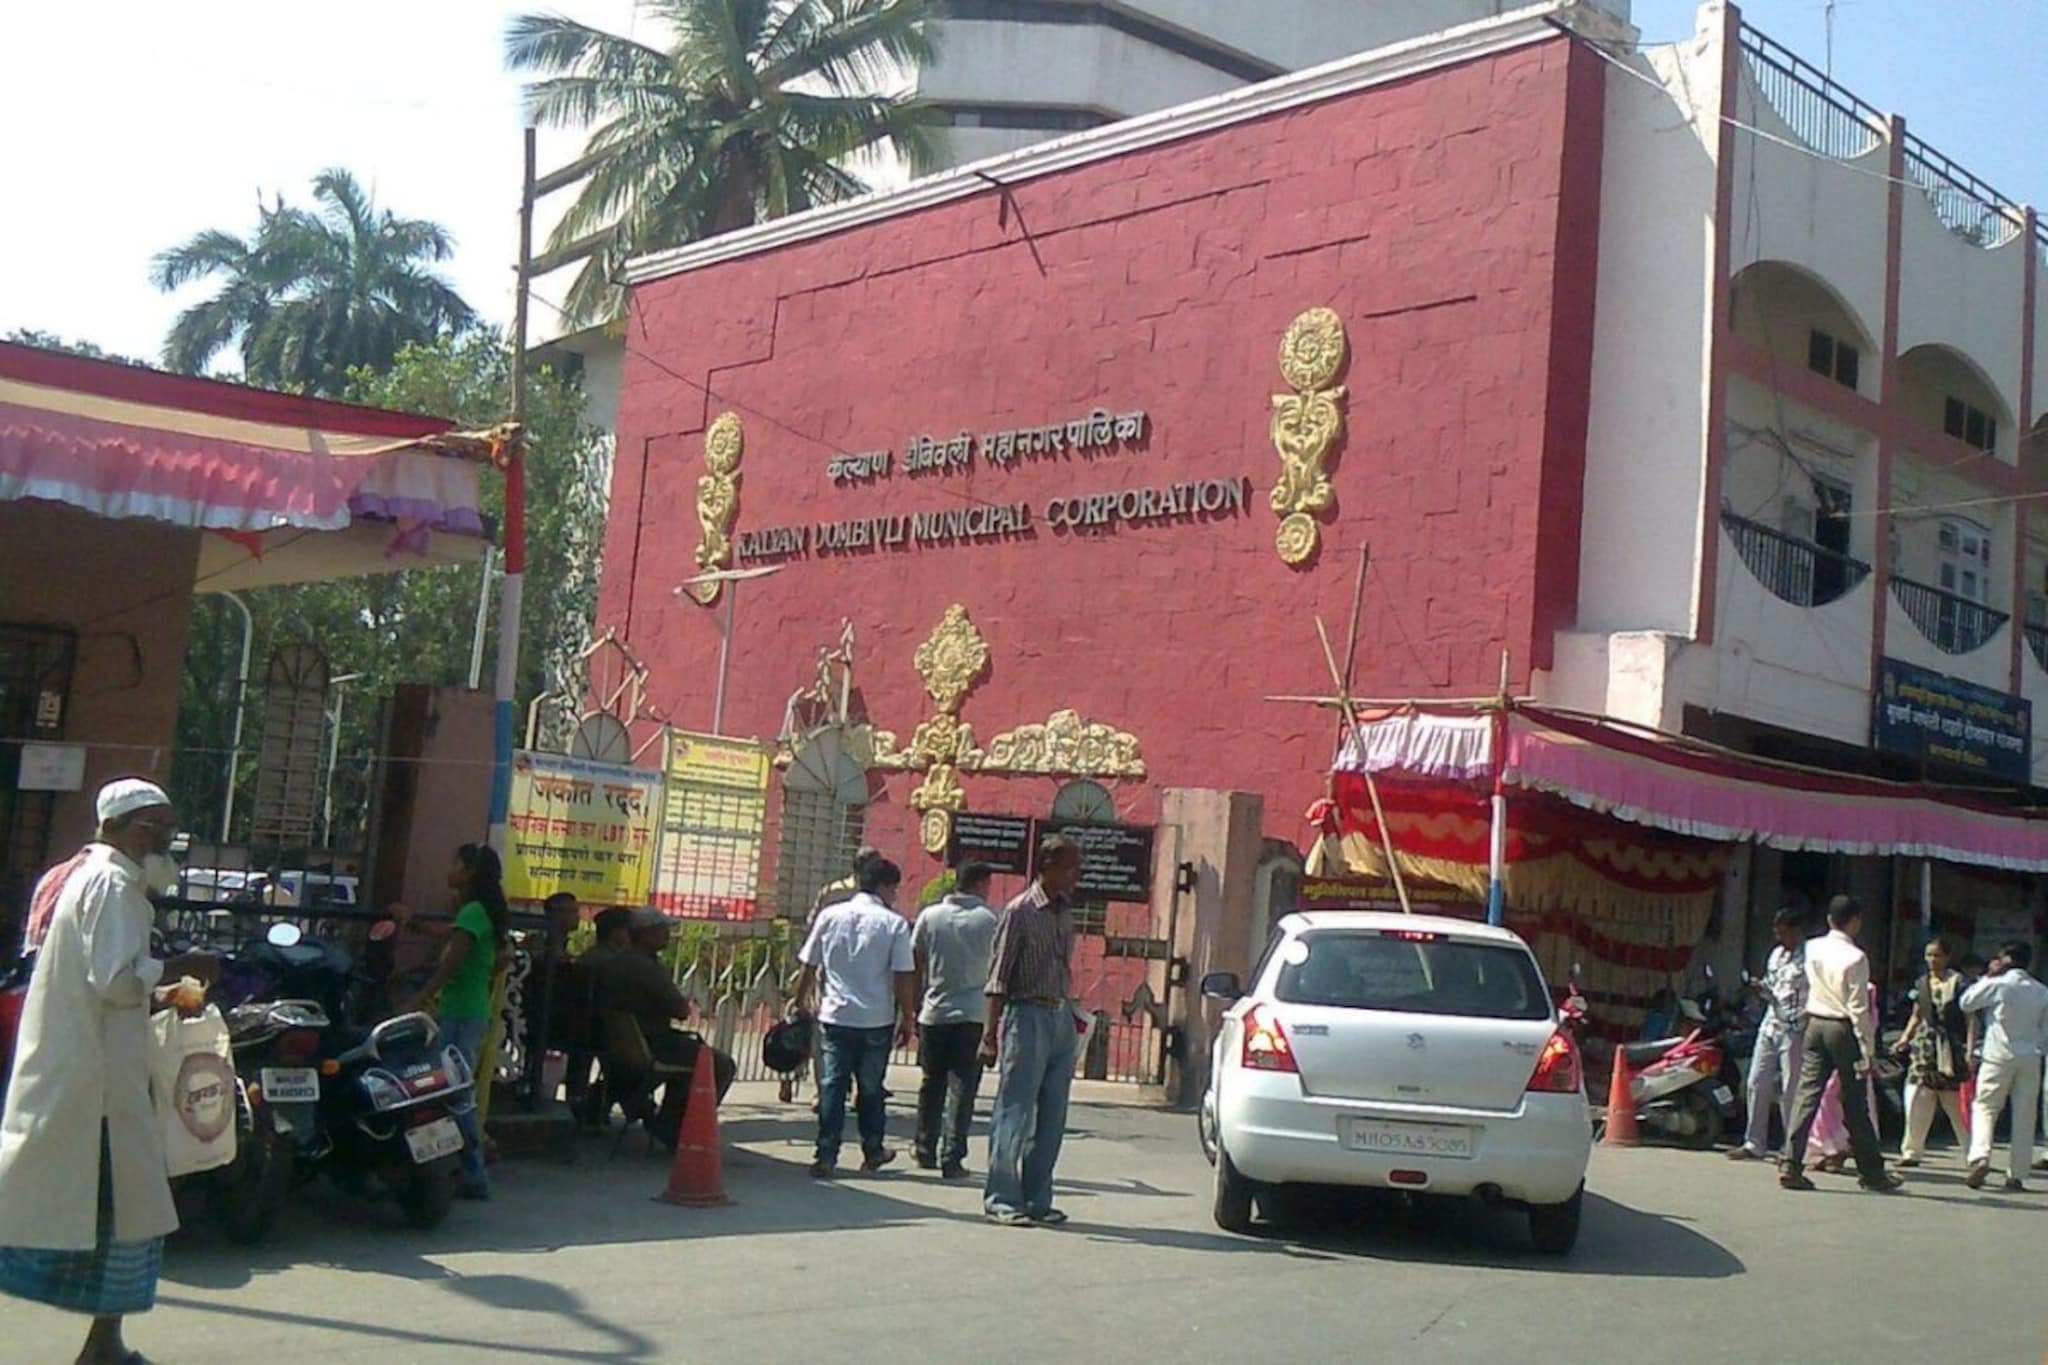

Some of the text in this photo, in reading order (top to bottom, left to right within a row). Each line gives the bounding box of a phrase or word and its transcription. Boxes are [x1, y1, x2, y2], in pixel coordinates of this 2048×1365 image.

[826, 450, 888, 480] कल्याण
[736, 526, 804, 558] KALYAN
[911, 502, 1031, 540] MUNICIPAL
[1045, 478, 1246, 528] CORPORATION
